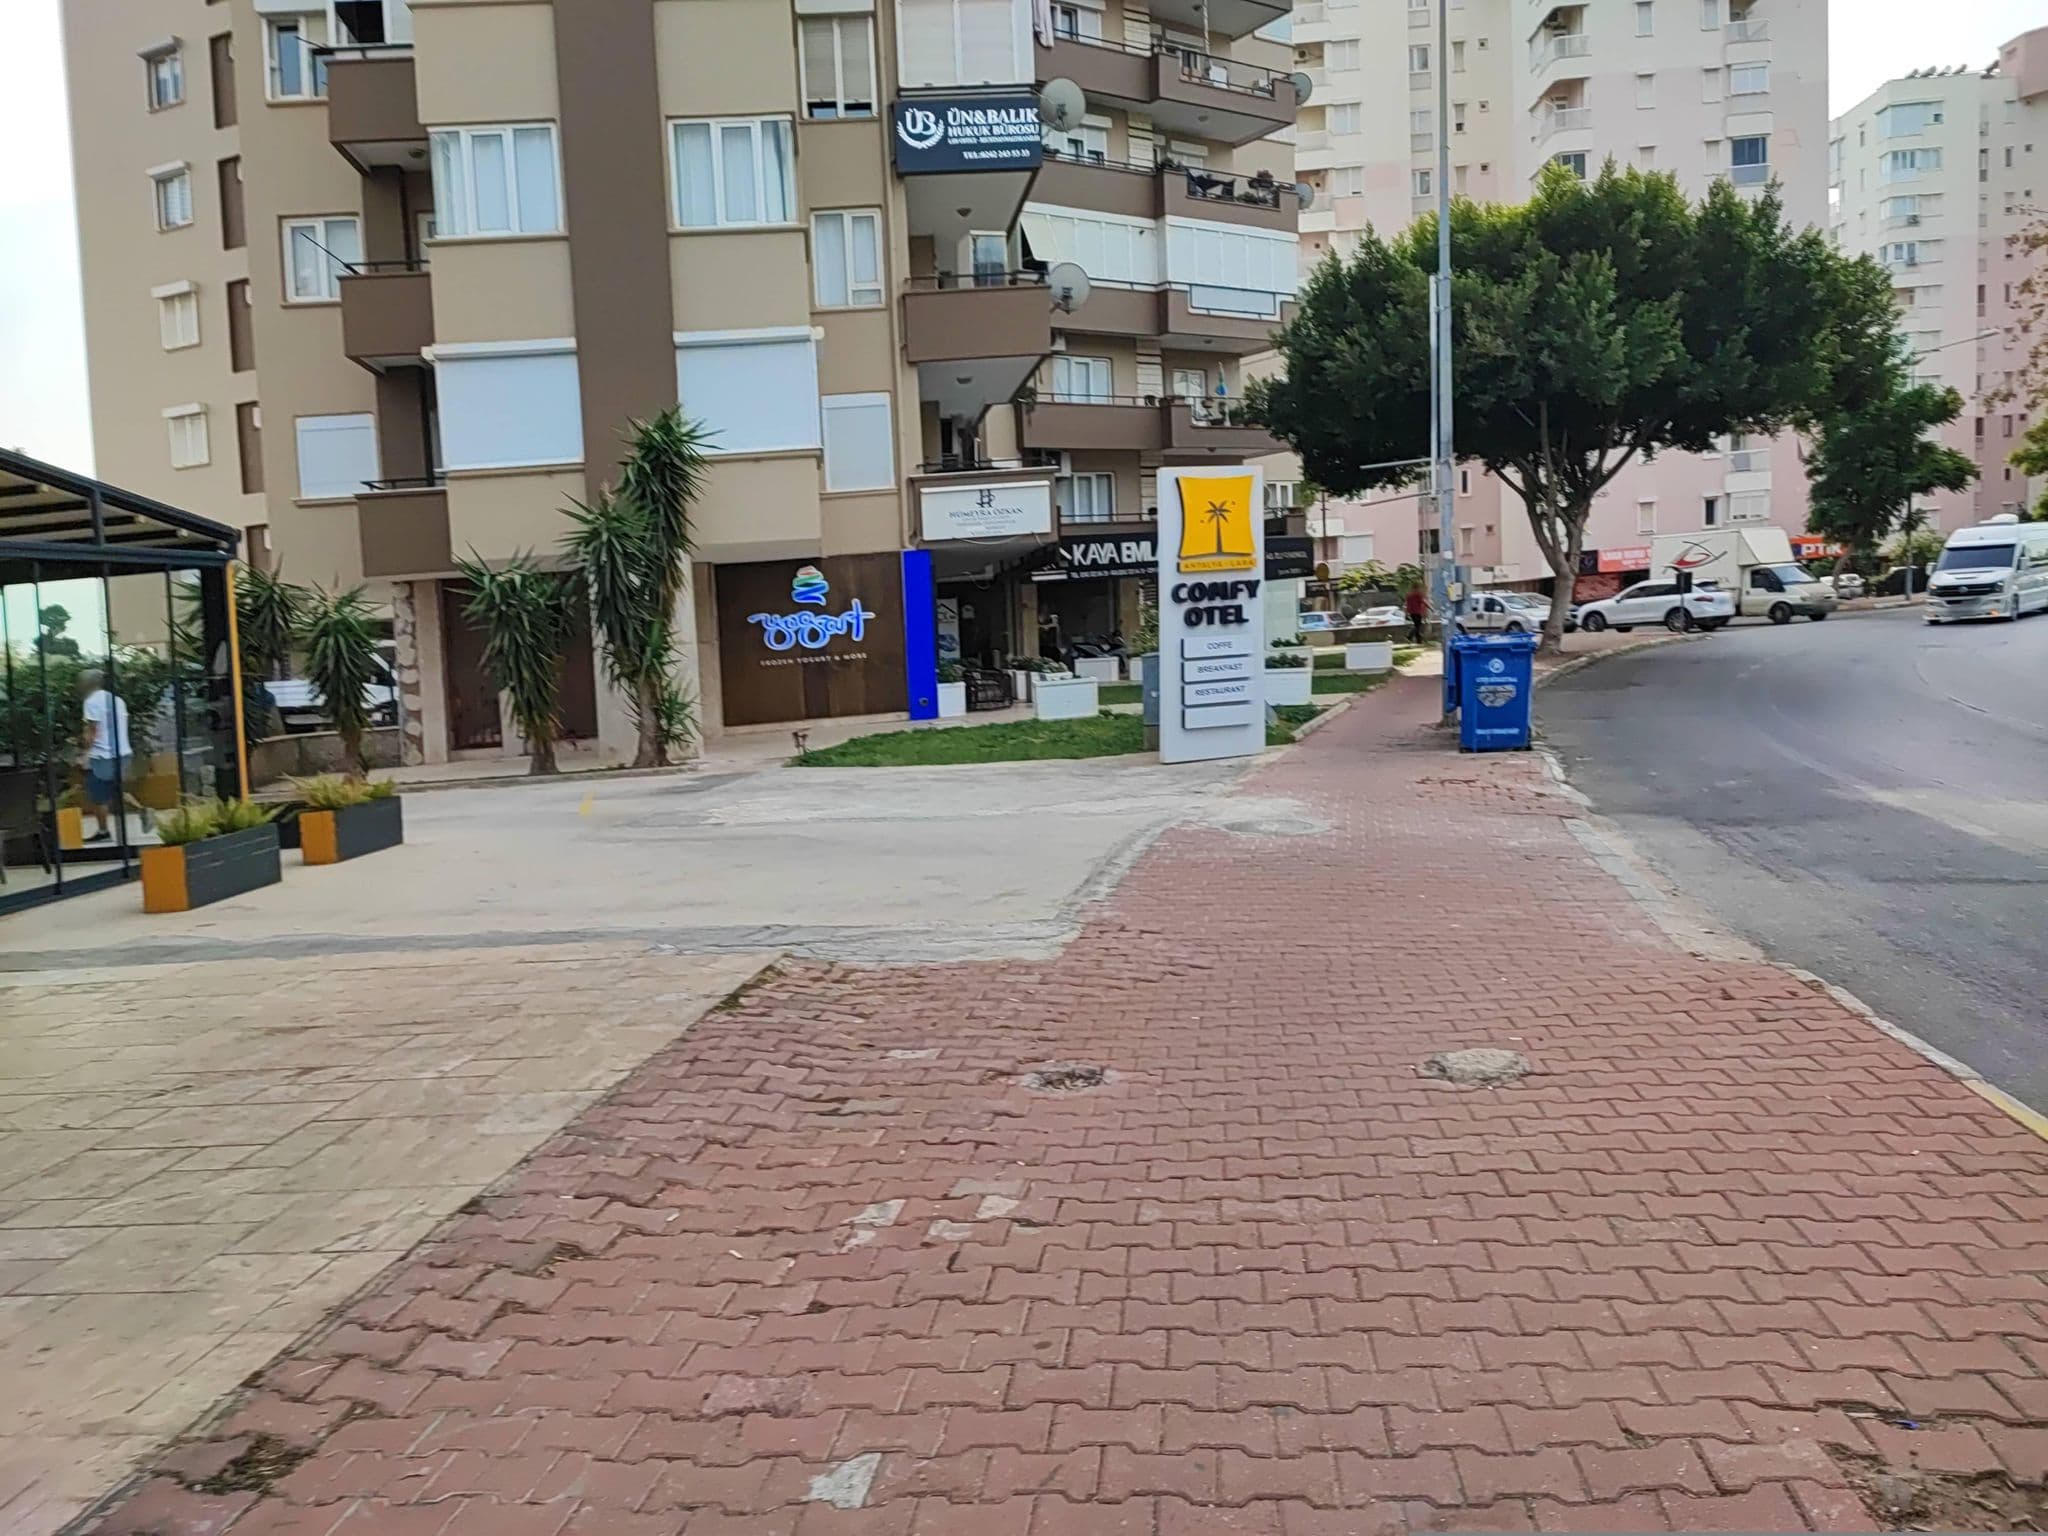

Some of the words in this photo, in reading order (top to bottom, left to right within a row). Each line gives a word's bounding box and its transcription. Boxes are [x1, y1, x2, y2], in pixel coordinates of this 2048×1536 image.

[947, 106, 1039, 126] ÜN&BALIK
[947, 125, 991, 137] HUKUK
[992, 122, 1039, 136] BÜROSU
[1072, 542, 1121, 566] KAYA
[1121, 540, 1159, 563] EML
[1171, 579, 1261, 604] COMFY
[1184, 604, 1250, 627] OTEL
